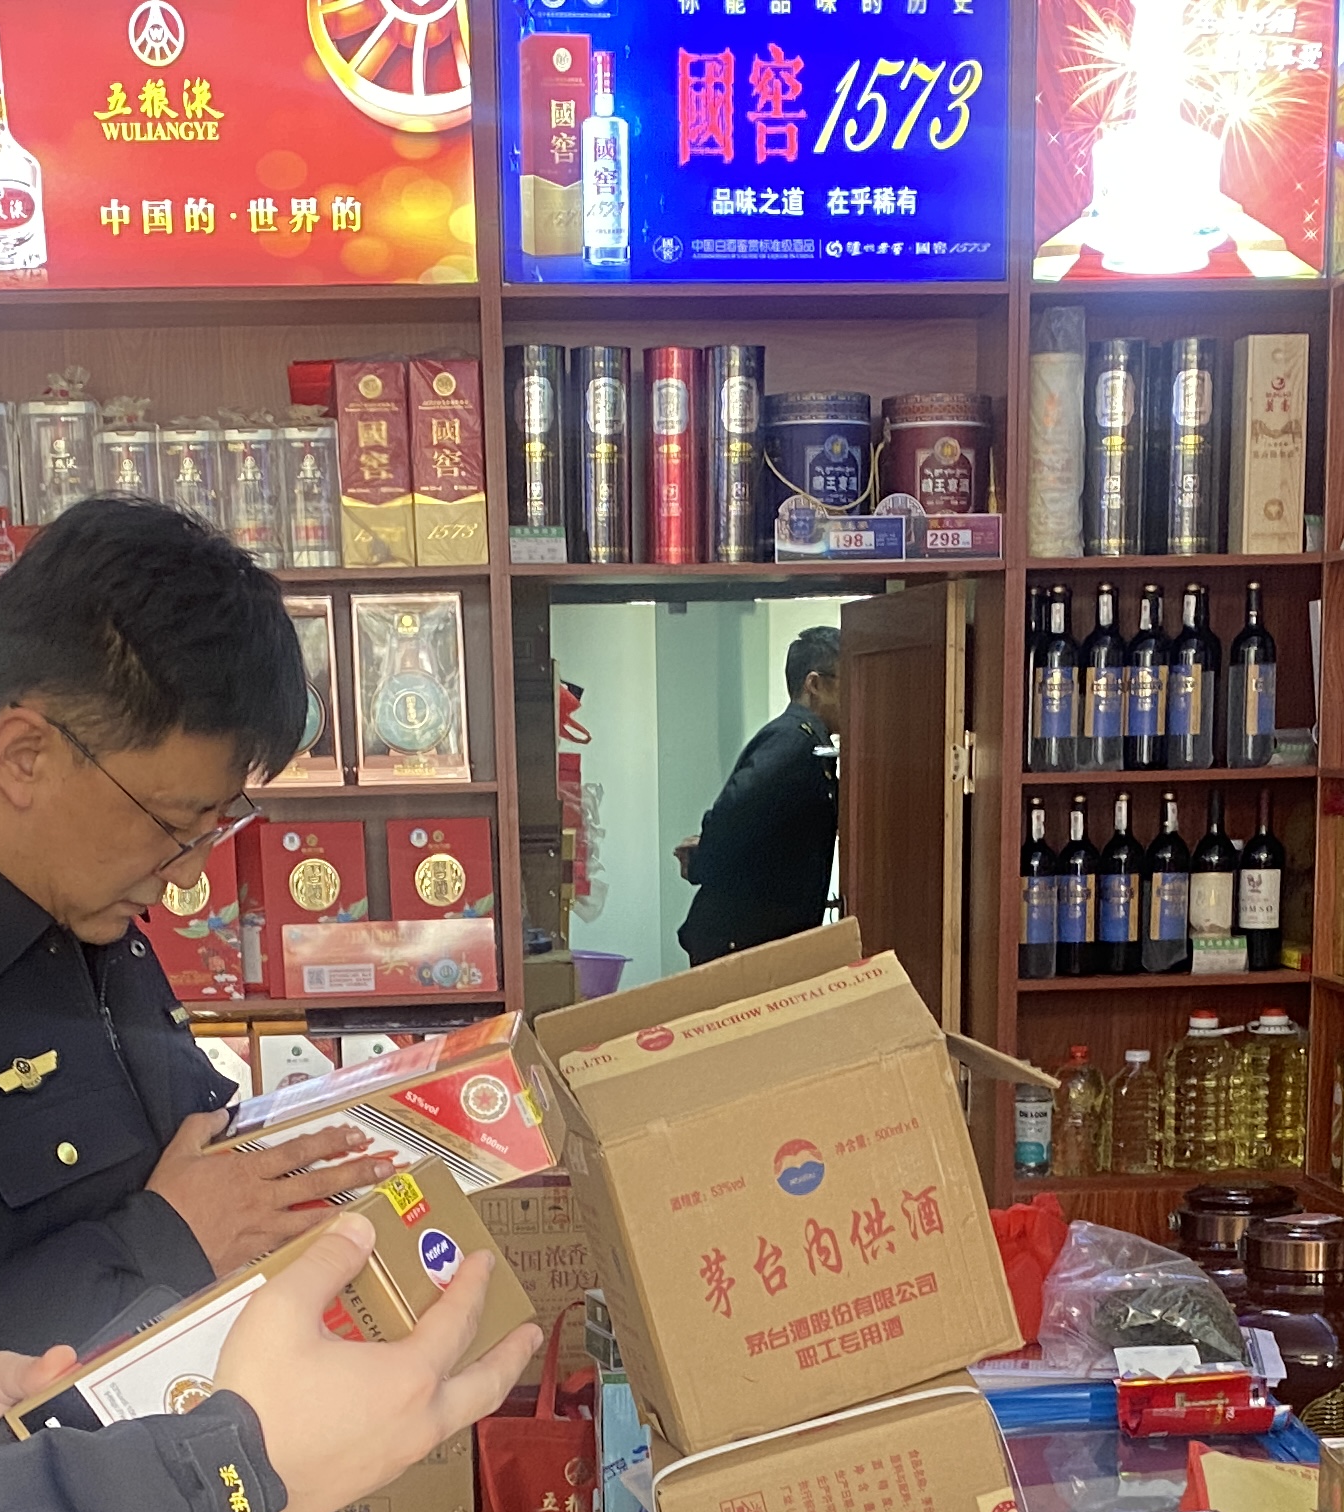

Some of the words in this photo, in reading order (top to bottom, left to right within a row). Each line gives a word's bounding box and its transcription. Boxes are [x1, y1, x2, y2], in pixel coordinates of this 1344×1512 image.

[93, 77, 225, 121] 五粮液
[813, 57, 983, 154] 1573
[101, 122, 221, 141] WULIANGYE
[100, 196, 362, 234] 中国的·世界的
[712, 188, 804, 216] 品味之道
[827, 188, 918, 216] 在乎稀有
[427, 523, 478, 540] 1573
[929, 532, 961, 547] 298
[681, 1006, 763, 1040] KWEICHOW
[766, 987, 825, 1014] MOUTAI
[404, 1090, 441, 1117] 53%vol
[479, 1131, 510, 1156] 500ml
[699, 1185, 945, 1319] 茅台内供酒
[744, 1271, 939, 1358] 茅台酒股份有限公司
[795, 1315, 905, 1370] 职工专用酒
